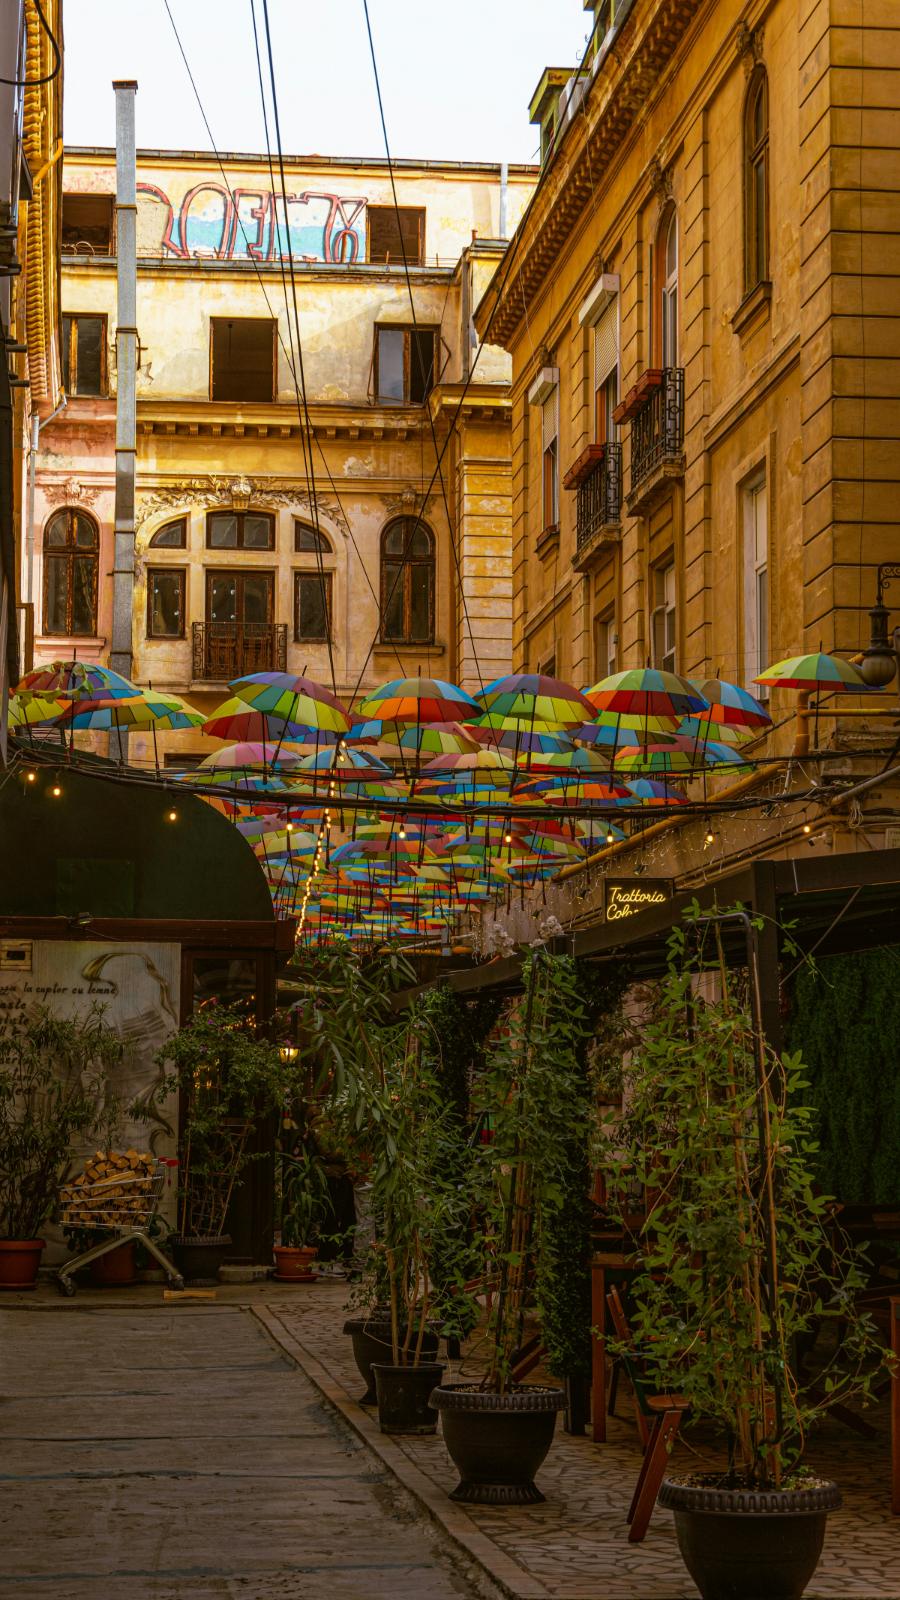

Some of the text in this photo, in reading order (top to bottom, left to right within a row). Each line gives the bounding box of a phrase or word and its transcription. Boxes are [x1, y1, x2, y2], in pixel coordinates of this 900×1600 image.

[609, 887, 666, 903] Trattoria
[24, 982, 33, 993] la
[36, 982, 68, 1001] cuptor
